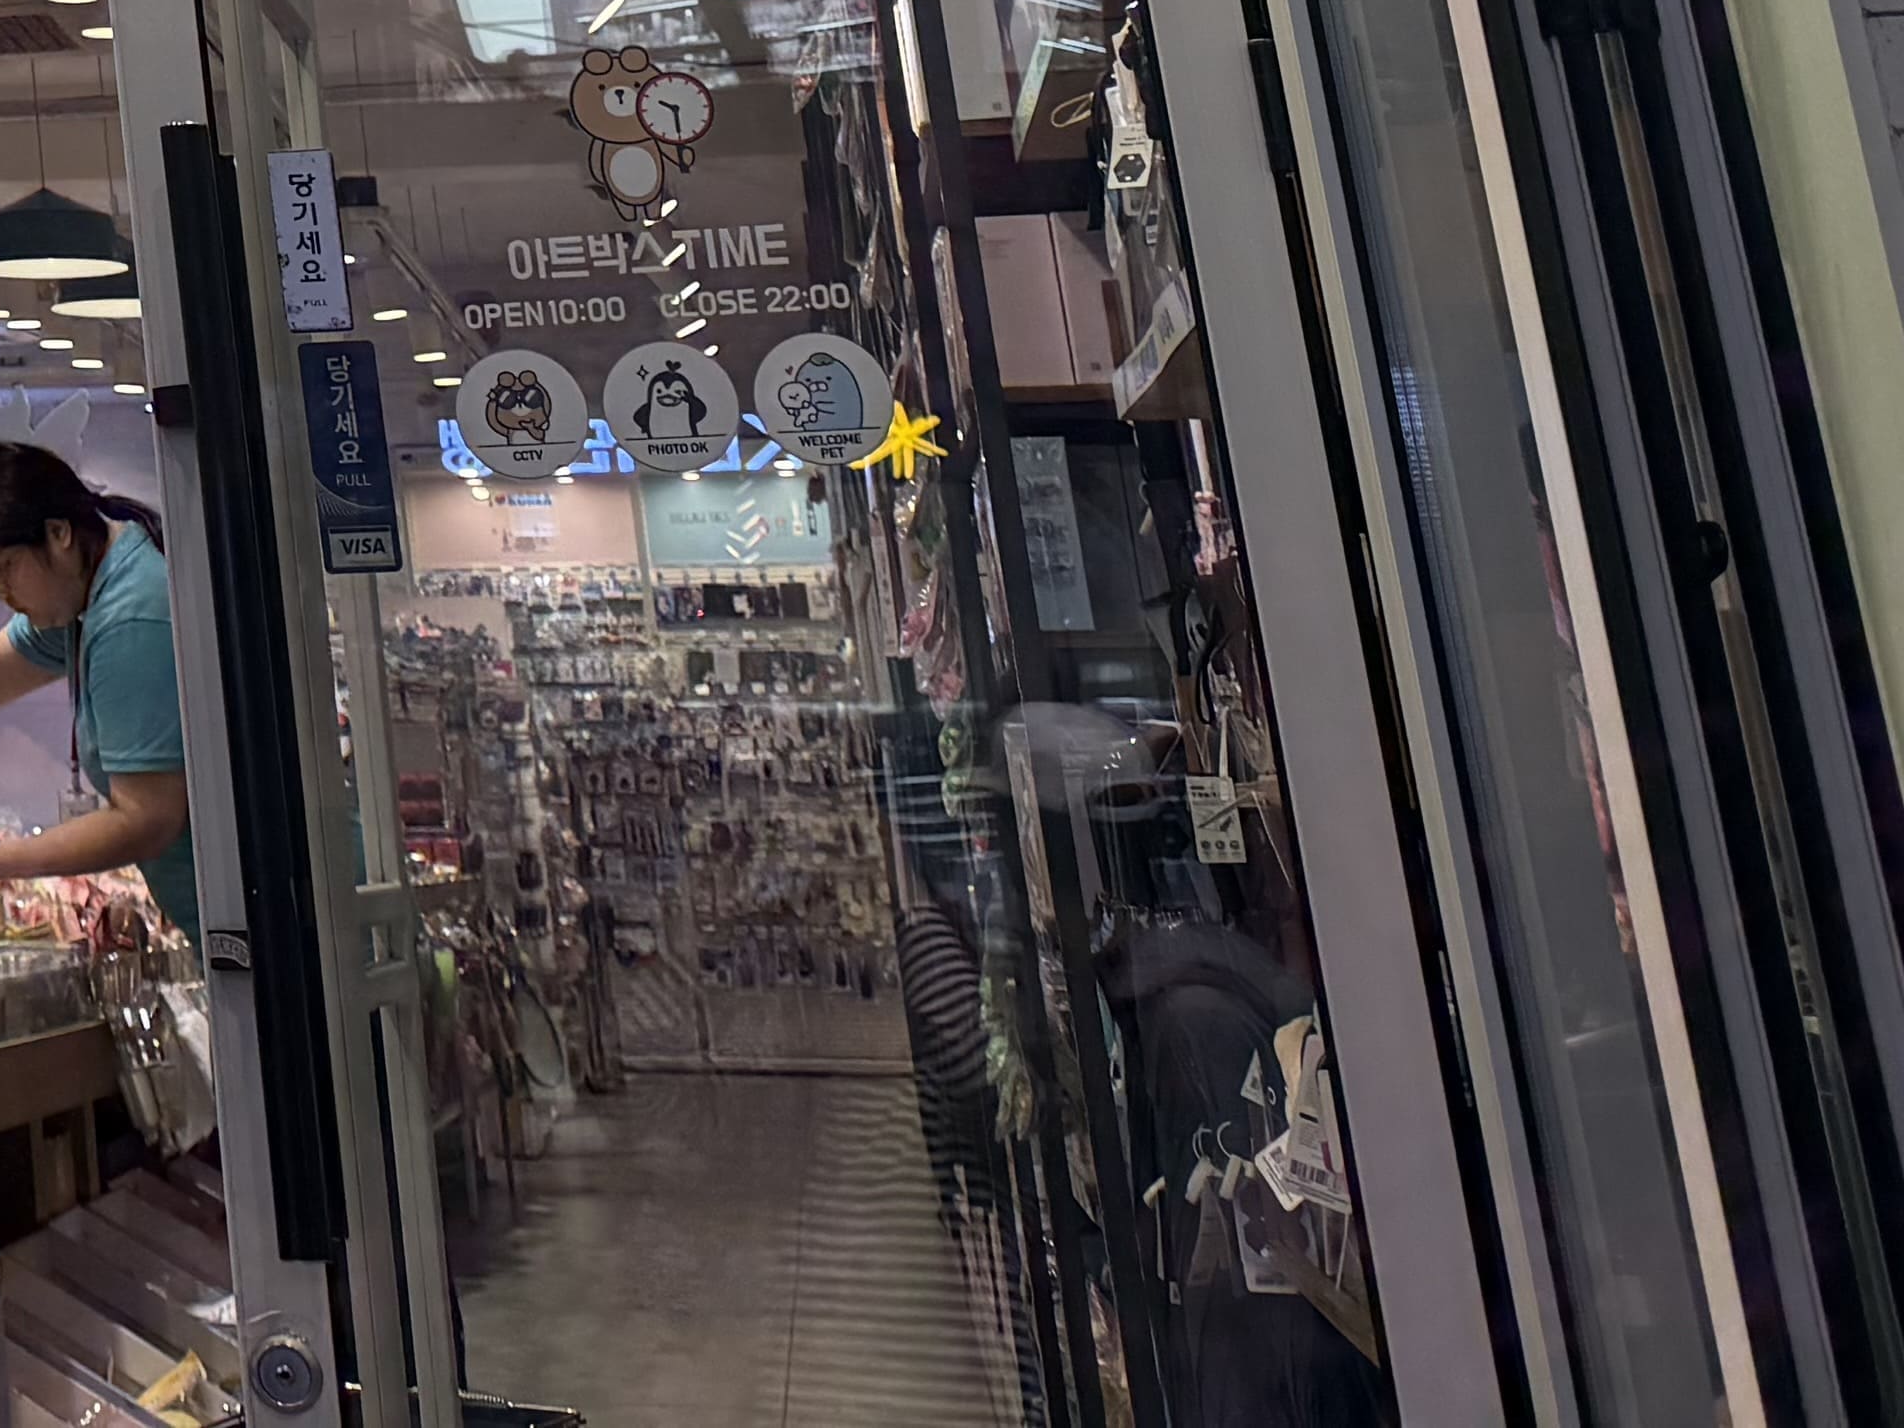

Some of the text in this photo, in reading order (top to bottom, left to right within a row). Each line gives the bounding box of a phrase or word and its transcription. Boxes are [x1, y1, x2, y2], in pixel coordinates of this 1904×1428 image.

[288, 173, 326, 284] 당기세요
[463, 282, 851, 330] OPEN 10:00 CLOSE 22:00
[325, 354, 364, 466] 당기세요
[799, 433, 863, 448] WELCOME
[512, 449, 544, 463] CCTV
[648, 441, 709, 456] PHOTO OK
[820, 446, 846, 459] PET
[336, 472, 372, 487] PULL
[339, 537, 387, 557] VISA
